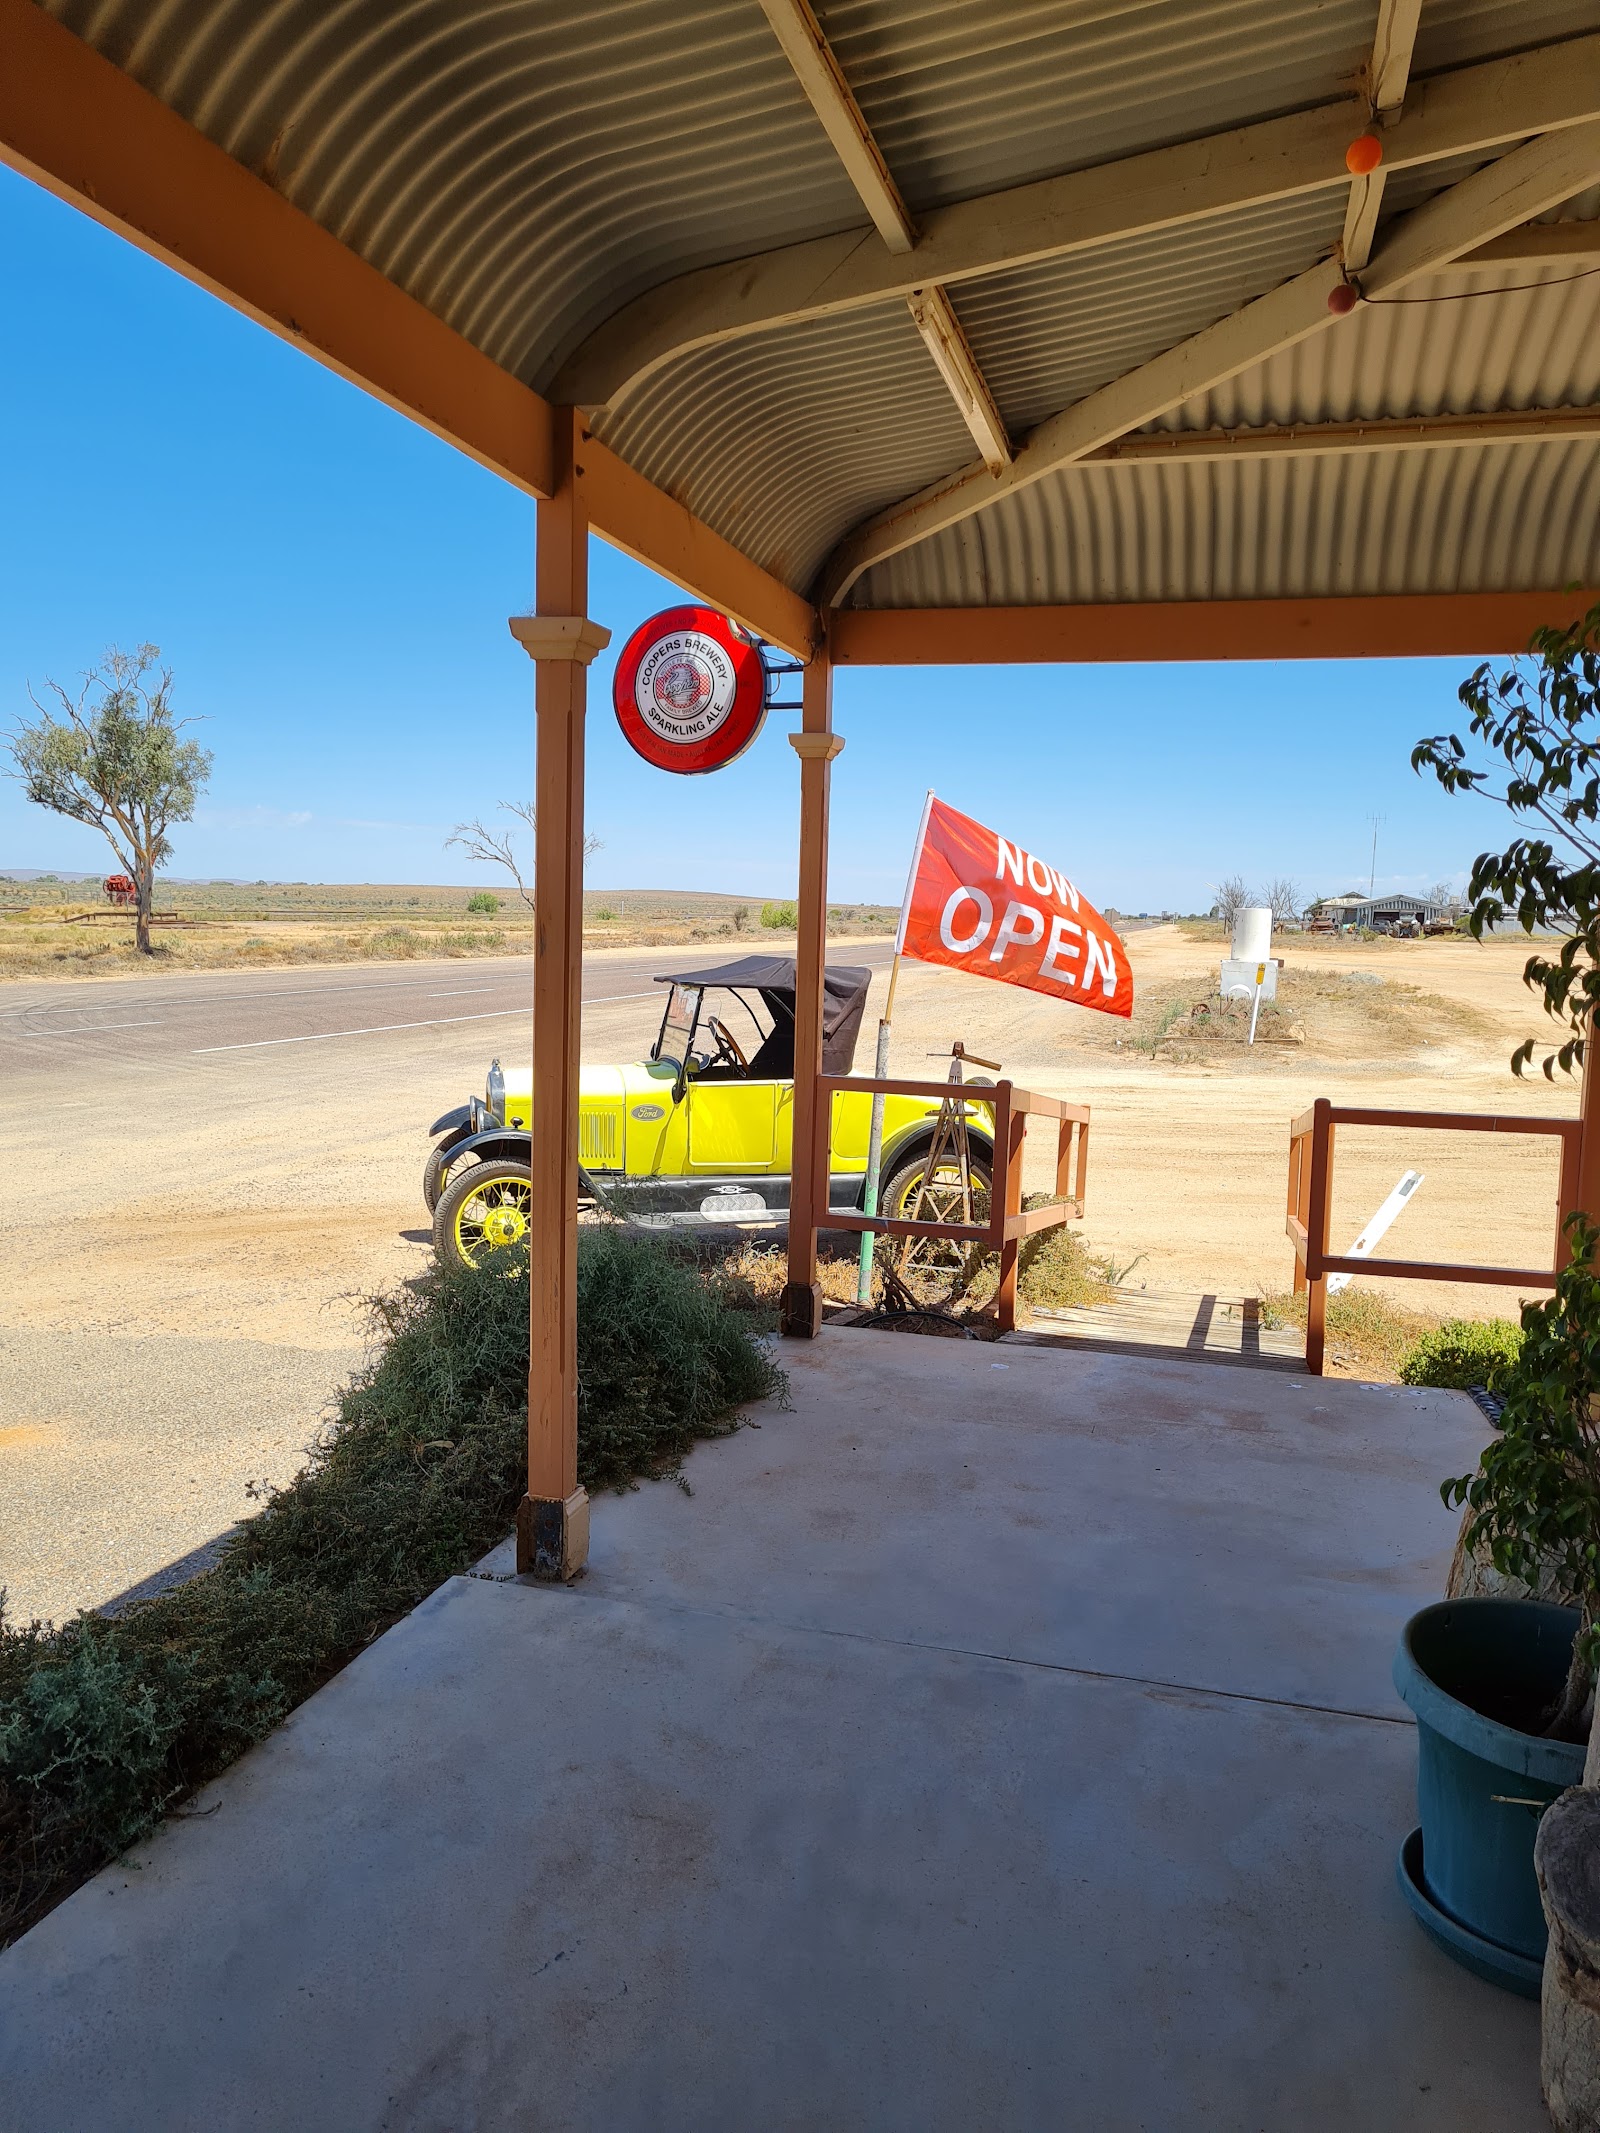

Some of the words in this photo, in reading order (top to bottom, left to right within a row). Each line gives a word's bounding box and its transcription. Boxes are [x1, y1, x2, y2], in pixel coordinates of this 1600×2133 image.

[642, 639, 681, 686] COOPERS
[685, 638, 729, 680] BREWERY
[648, 707, 706, 736] SPARKLING
[706, 702, 724, 725] ALE
[664, 703, 681, 714] FAMILY
[681, 700, 703, 714] BREWED
[995, 835, 1080, 914] NOW
[939, 885, 1118, 998] OPEN
[638, 1106, 658, 1118] Ford
